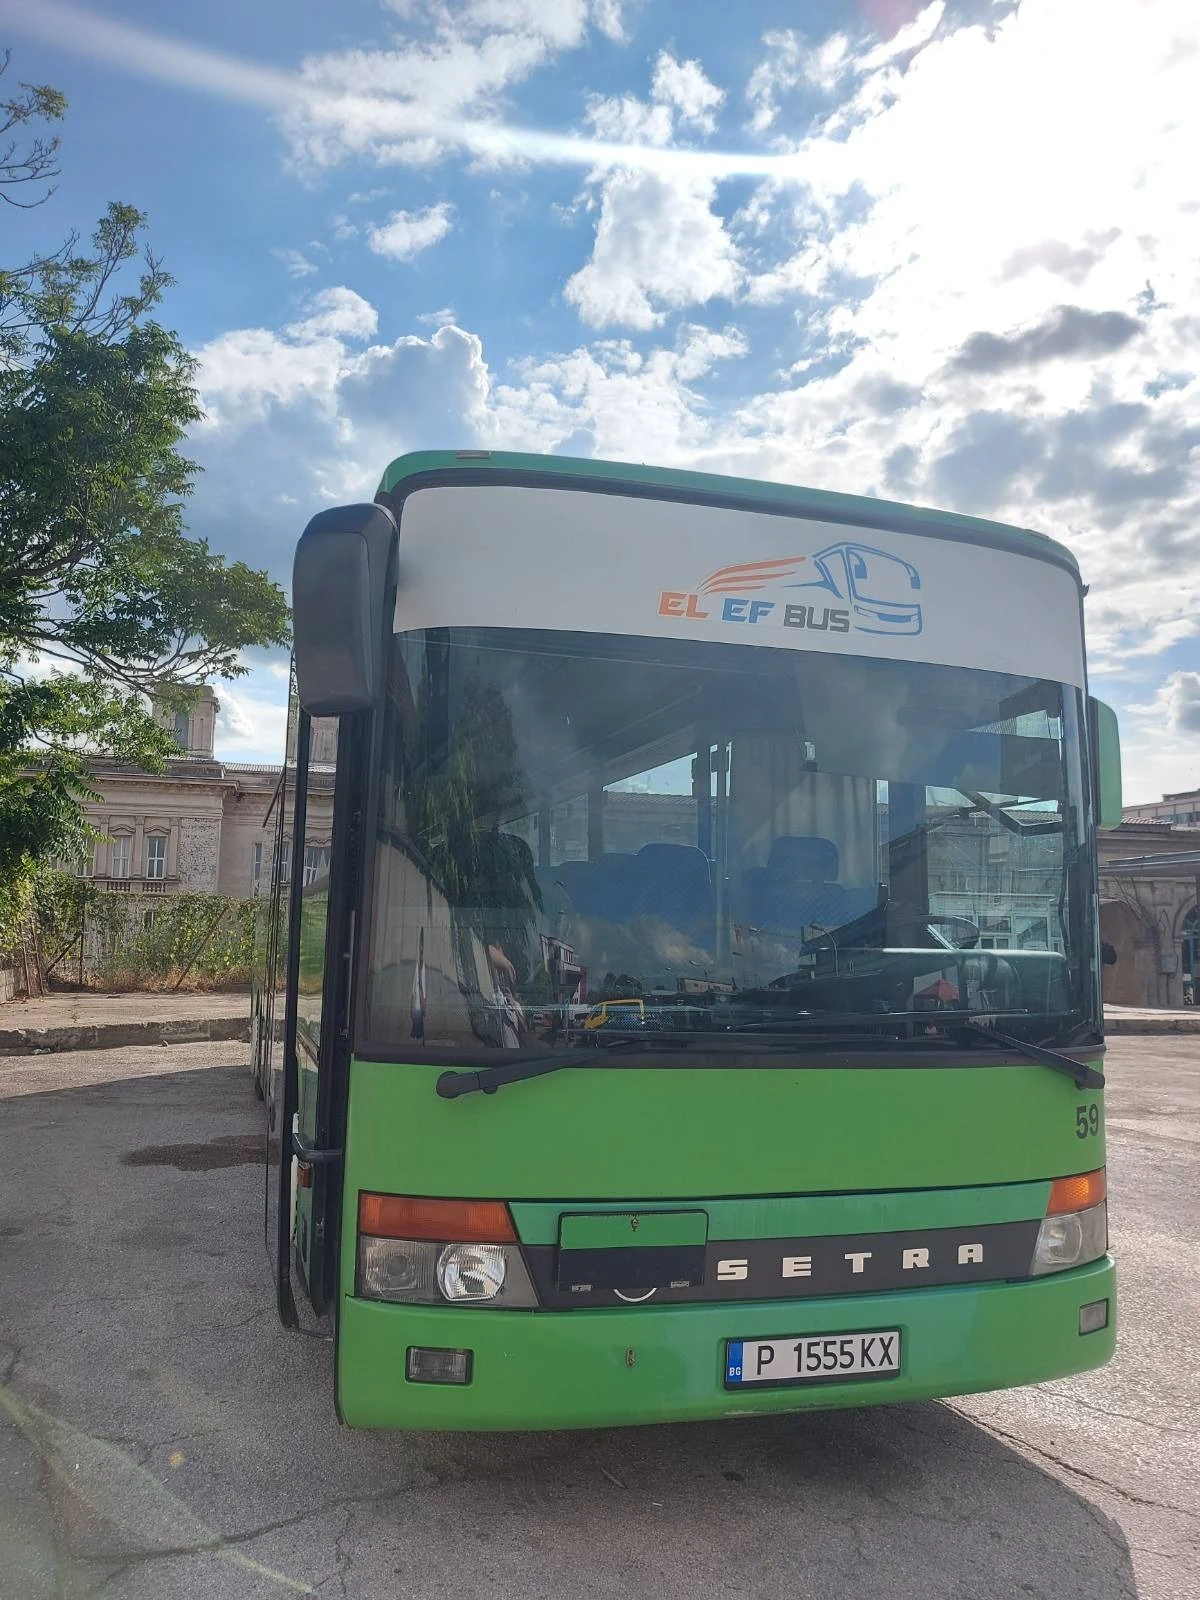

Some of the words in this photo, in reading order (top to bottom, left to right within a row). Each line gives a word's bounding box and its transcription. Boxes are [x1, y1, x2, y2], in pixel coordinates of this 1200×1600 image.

[658, 592, 709, 619] EL
[721, 598, 775, 624] EF
[783, 604, 850, 633] BUS
[1075, 1103, 1099, 1139] 59
[717, 1243, 984, 1281] SETRA
[729, 1367, 741, 1377] BG
[756, 1345, 775, 1375] P
